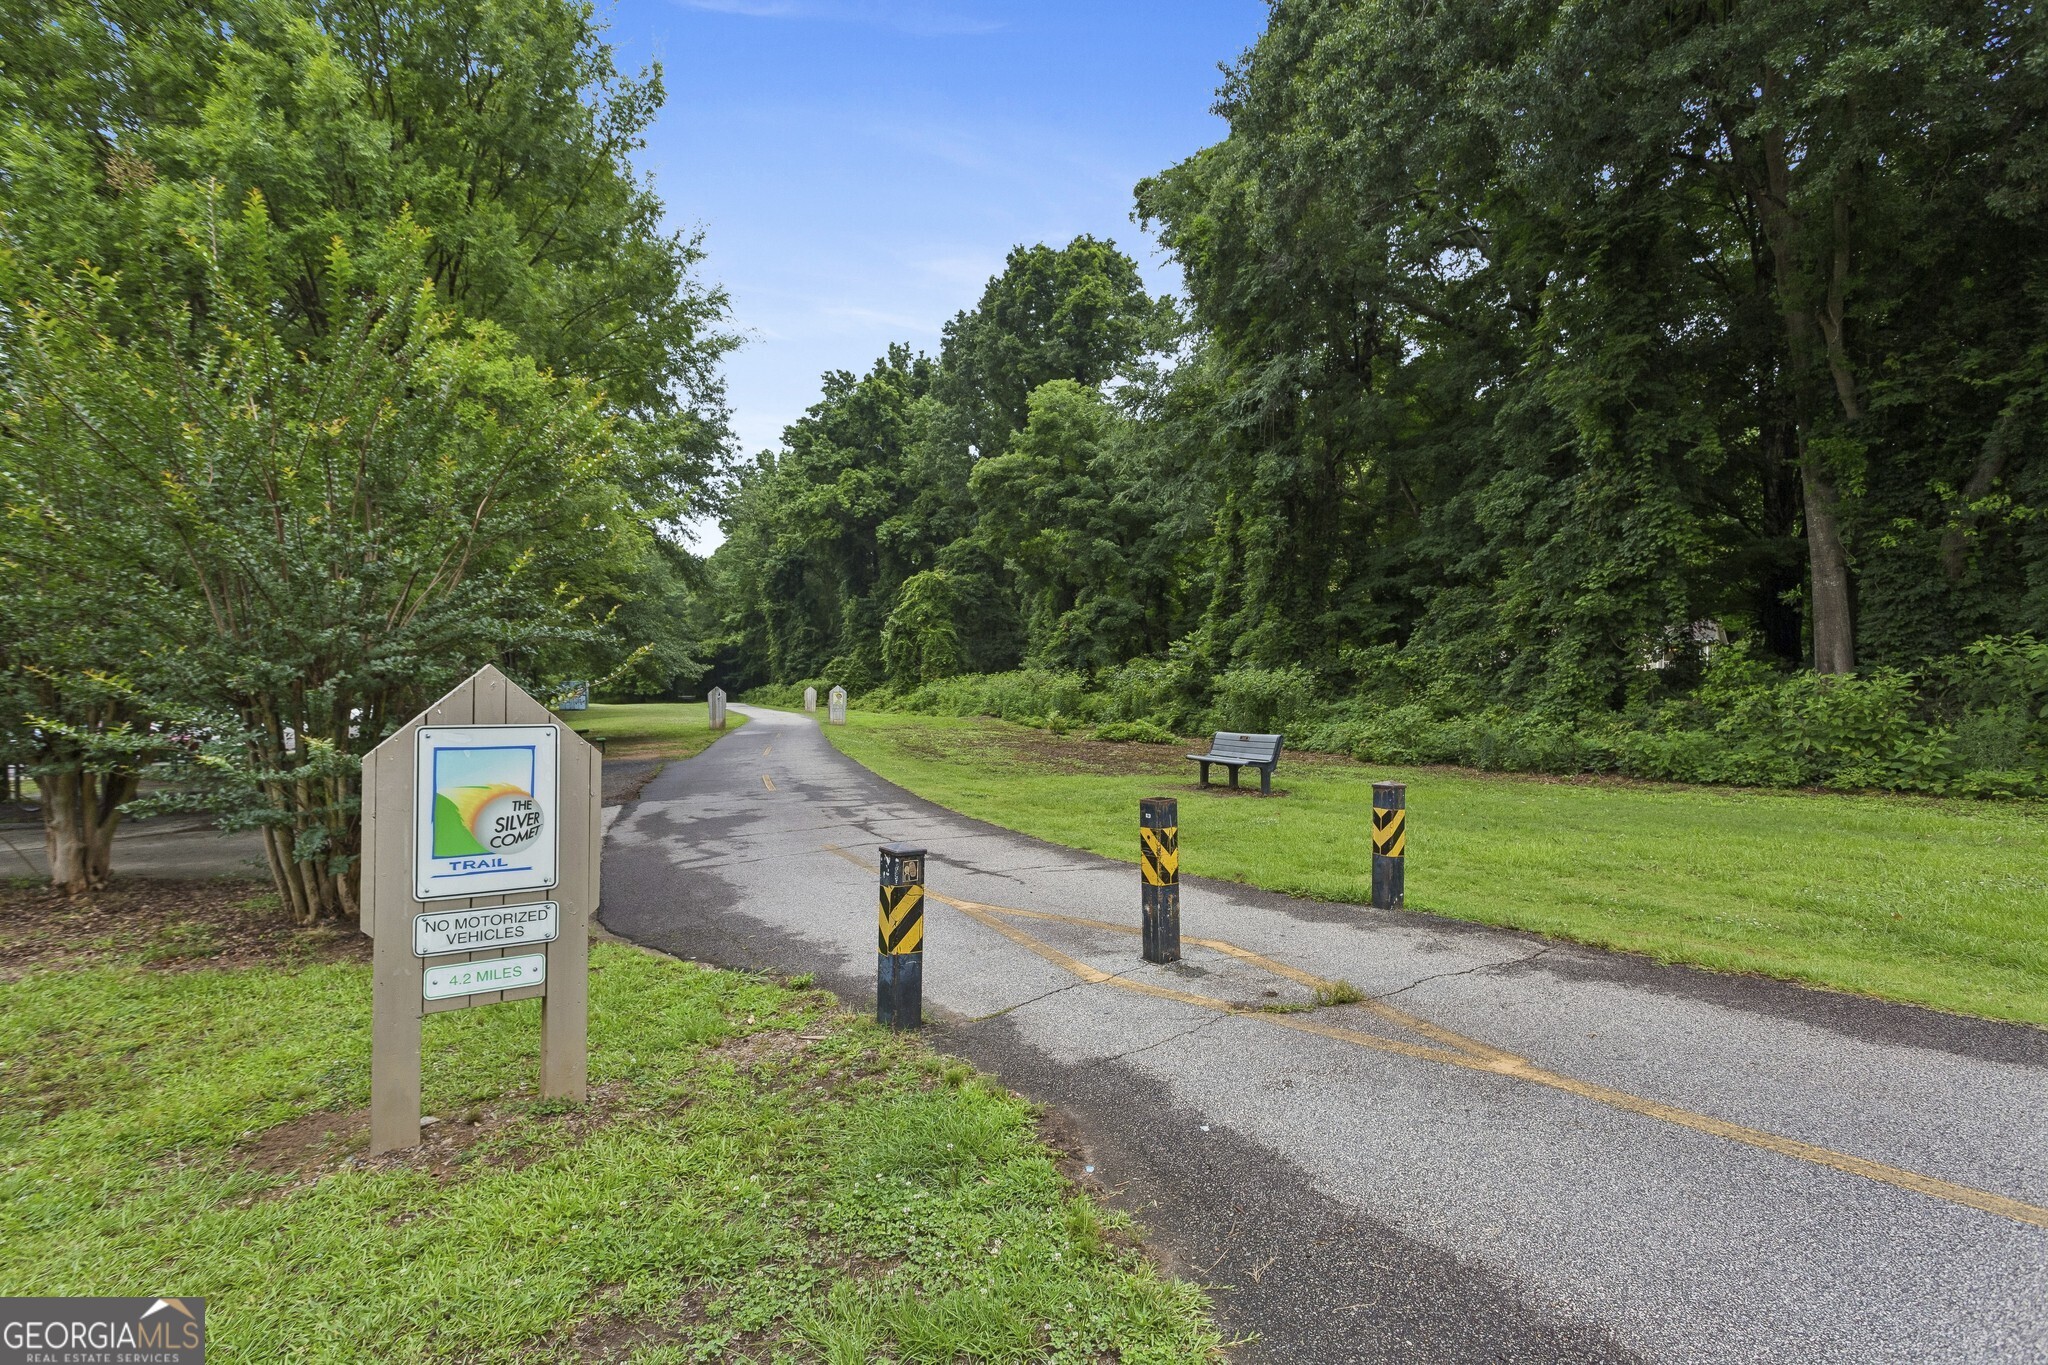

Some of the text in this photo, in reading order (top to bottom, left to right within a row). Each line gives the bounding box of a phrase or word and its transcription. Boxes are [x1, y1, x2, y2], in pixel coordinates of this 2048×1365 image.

[512, 799, 533, 812] THE
[494, 811, 540, 833] SILVER
[489, 823, 541, 849] COMET
[449, 858, 508, 871] TRAIL
[424, 909, 548, 933] NO MOTORIZED
[446, 925, 525, 945] VEHICLES
[449, 966, 522, 986] 4.2 MILES
